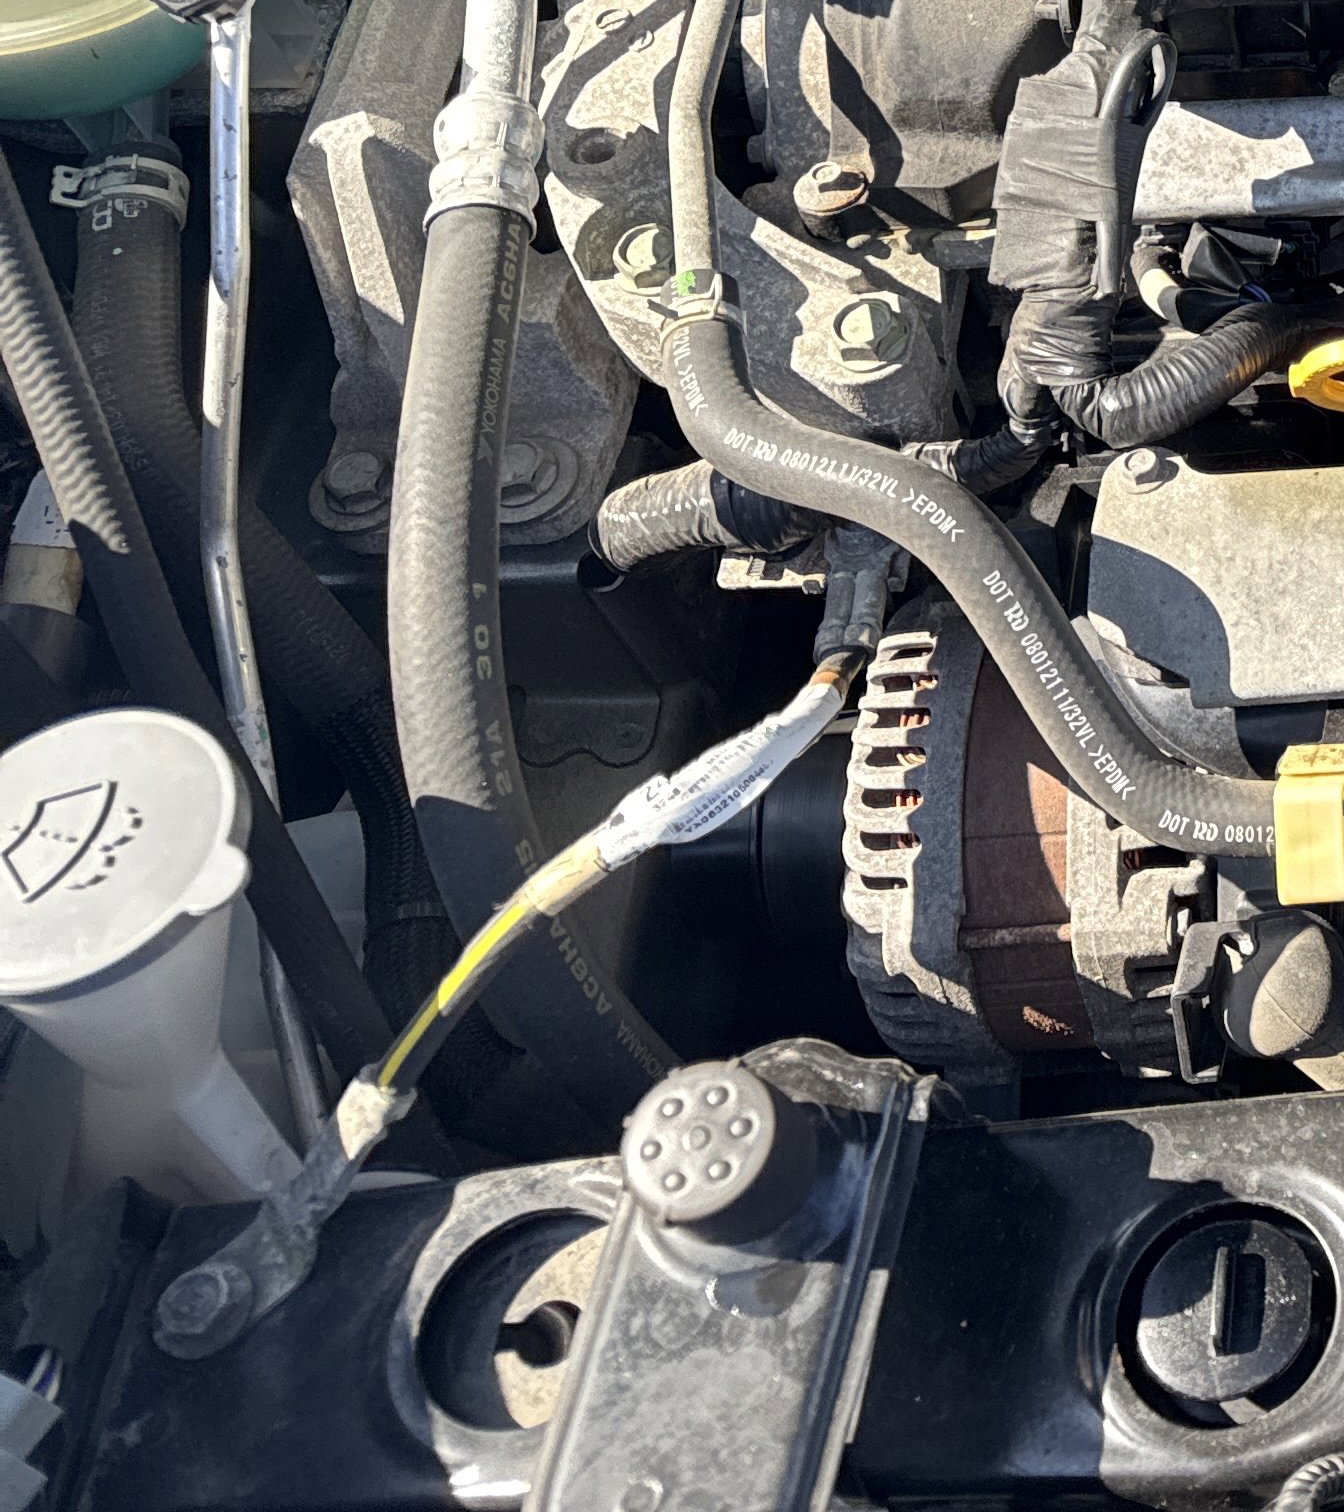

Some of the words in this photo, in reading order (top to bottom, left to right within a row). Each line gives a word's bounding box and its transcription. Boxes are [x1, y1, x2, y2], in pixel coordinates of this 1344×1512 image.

[481, 337, 507, 434] YOKOHAMA
[723, 427, 755, 453] DOT
[982, 569, 1014, 603] DOT
[1158, 809, 1190, 836] DOT
[1224, 824, 1275, 844] 08012
